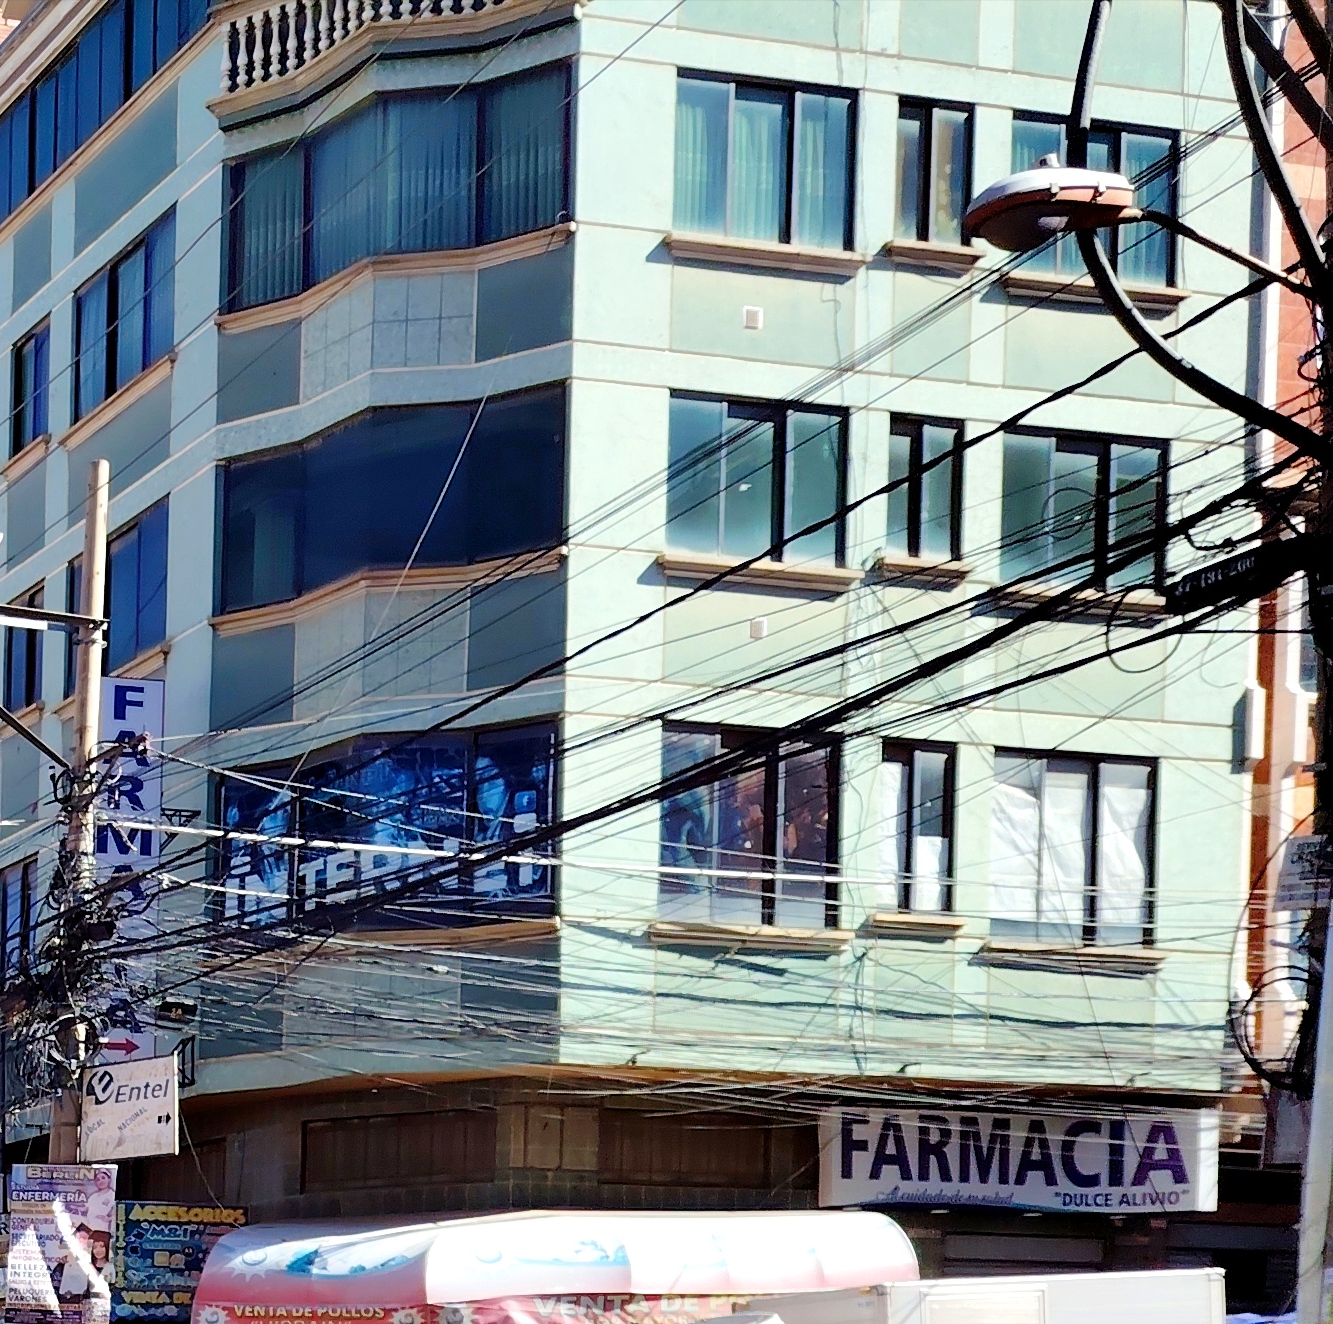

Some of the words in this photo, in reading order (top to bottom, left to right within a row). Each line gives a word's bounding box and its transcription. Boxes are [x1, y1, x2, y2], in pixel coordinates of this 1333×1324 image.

[114, 1078, 170, 1104] Entel
[117, 1106, 148, 1133] NACIONAL
[839, 1110, 1191, 1188] FARMACIA
[11, 1190, 88, 1203] ENFERMERÍA
[1054, 1191, 1114, 1208] "DULCE
[234, 1304, 288, 1317] VENTA
[291, 1304, 312, 1317] DE
[317, 1305, 386, 1319] POLLOS
[533, 1295, 652, 1317] VENTA
[660, 1294, 702, 1313] DE
